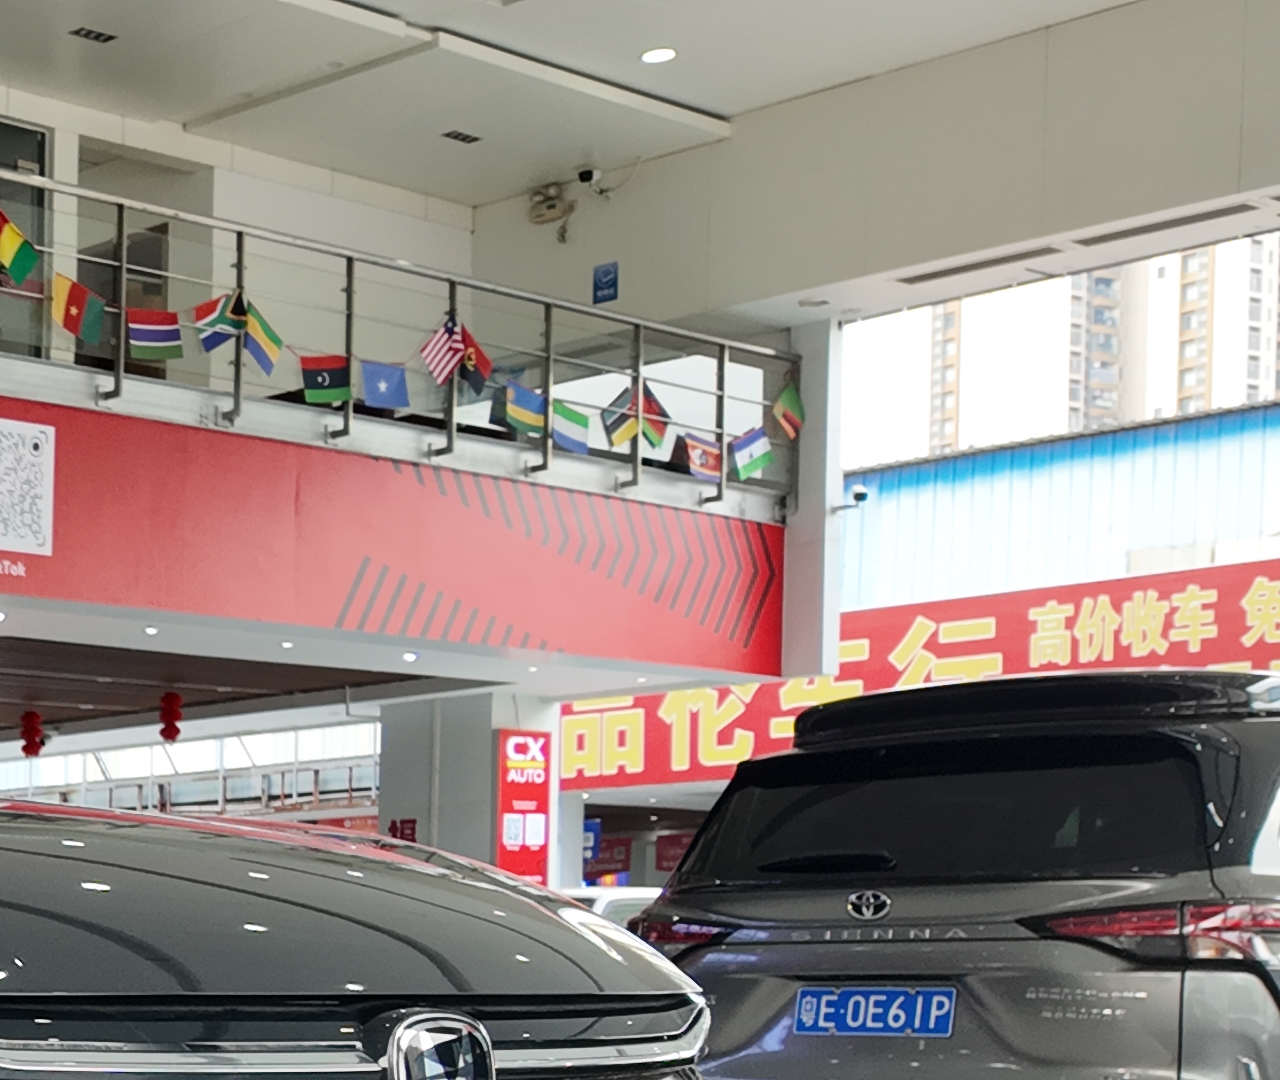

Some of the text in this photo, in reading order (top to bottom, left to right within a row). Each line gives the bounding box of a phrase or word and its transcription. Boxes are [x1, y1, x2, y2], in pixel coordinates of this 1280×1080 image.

[1028, 584, 1218, 668] 高价收车
[506, 735, 545, 762] CX
[506, 768, 545, 785] AUTO
[791, 928, 968, 941] SIENNA
